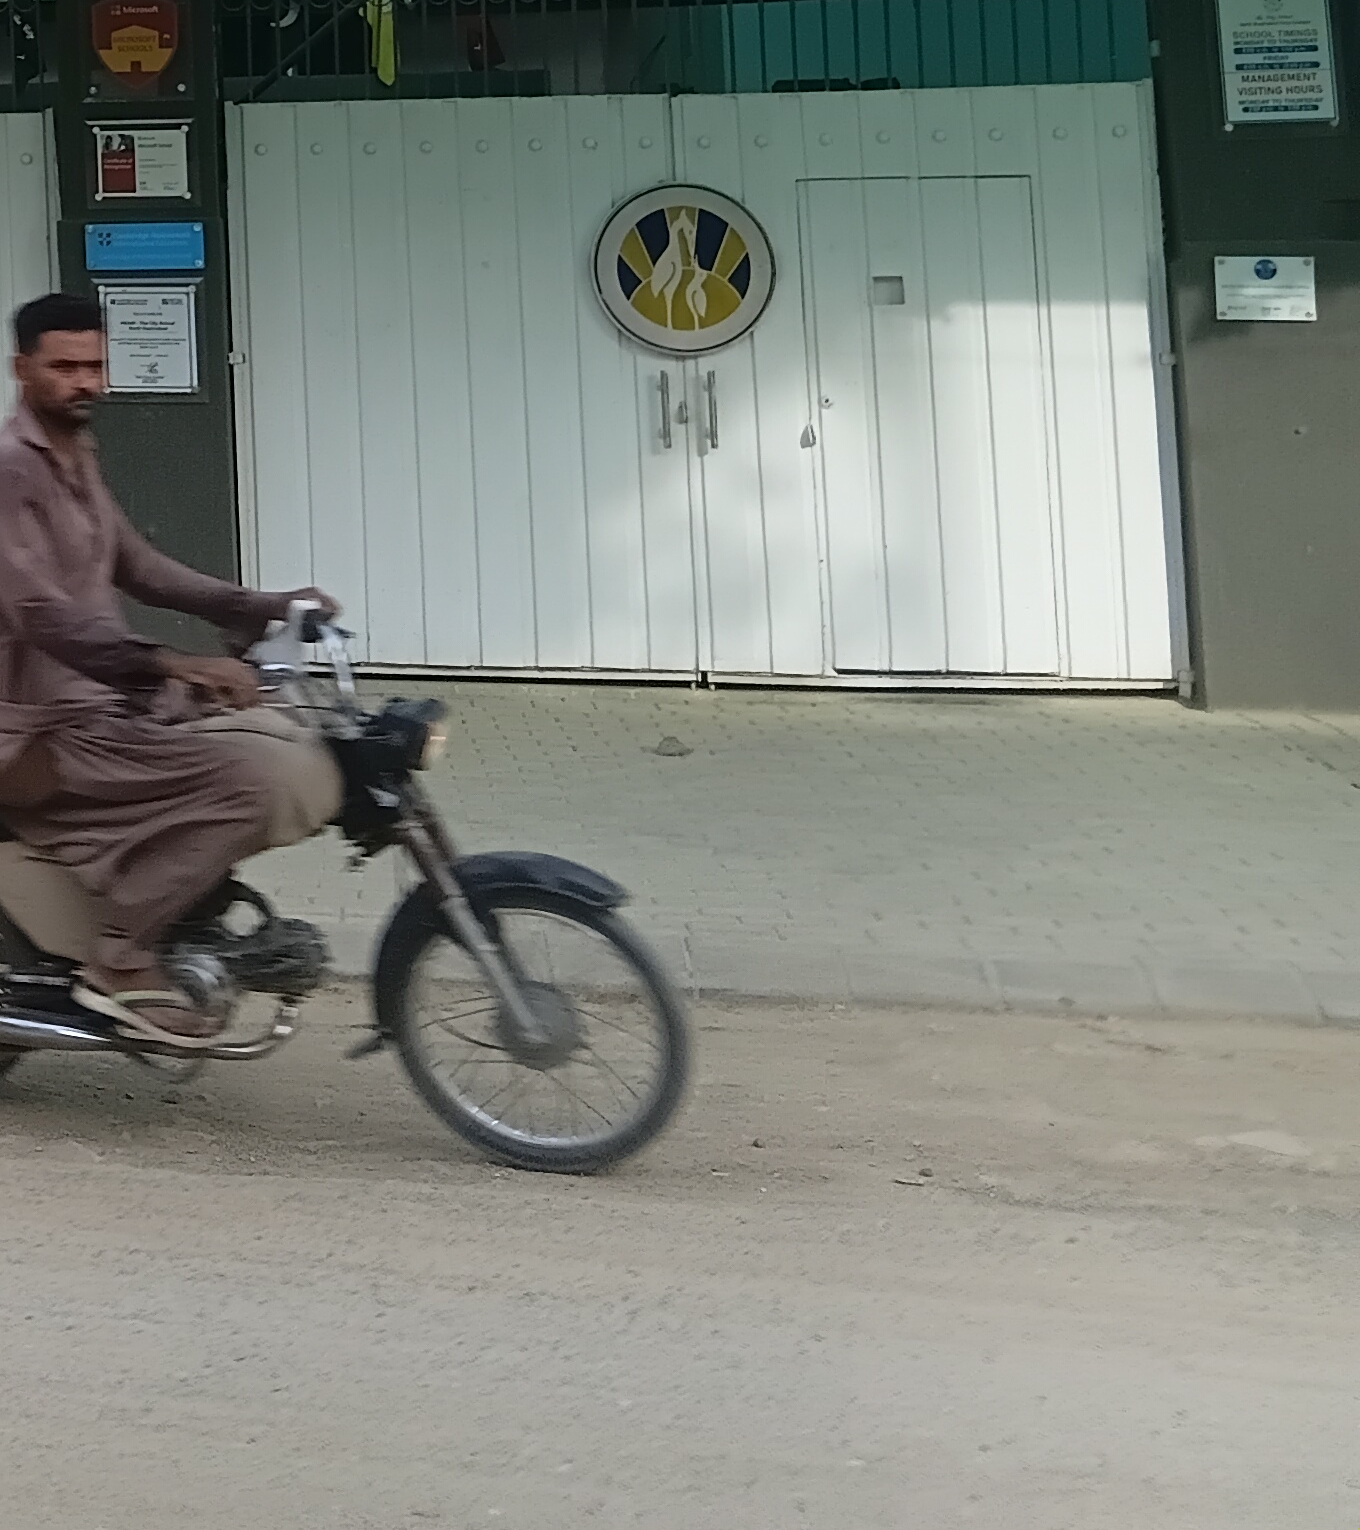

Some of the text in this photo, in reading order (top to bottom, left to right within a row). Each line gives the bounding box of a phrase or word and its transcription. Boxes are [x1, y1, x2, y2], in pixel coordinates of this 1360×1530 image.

[1241, 72, 1317, 83] MANAGEMENT
[1237, 84, 1324, 96] VISITING HOURS
